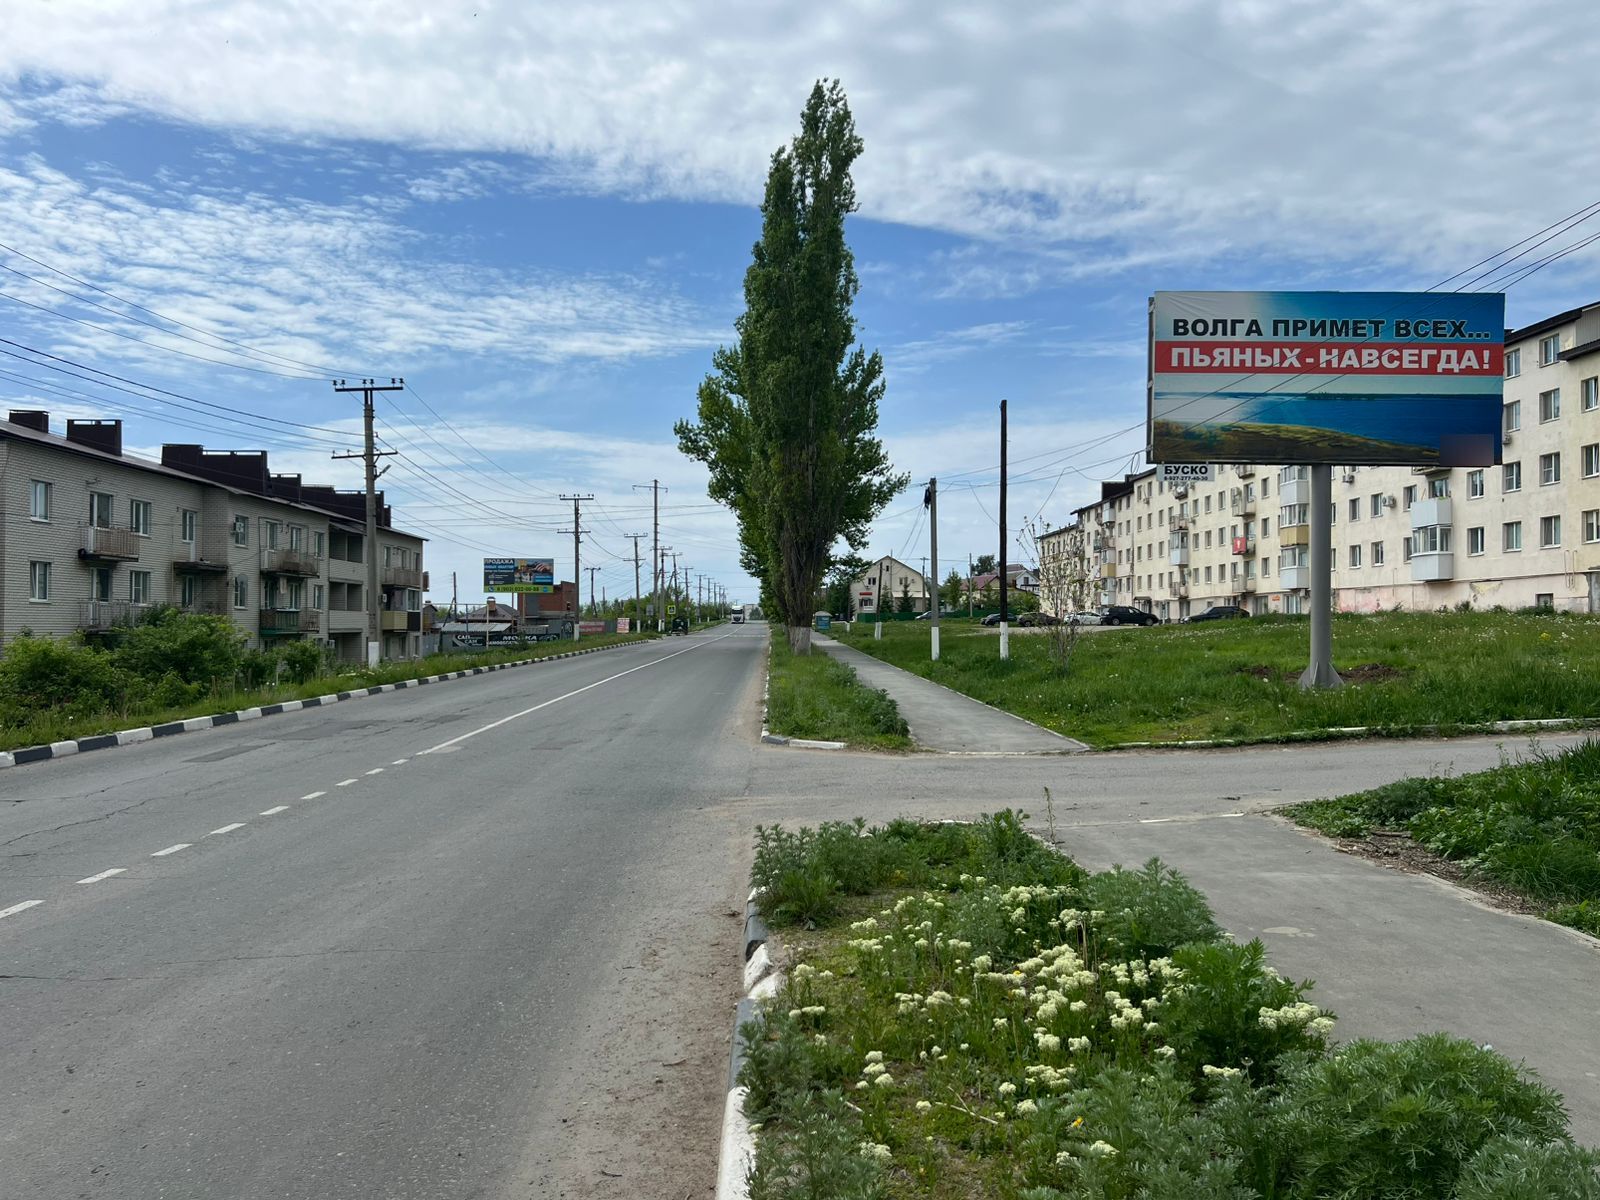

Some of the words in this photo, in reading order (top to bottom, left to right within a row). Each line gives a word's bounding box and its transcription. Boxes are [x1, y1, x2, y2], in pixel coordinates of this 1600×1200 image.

[1173, 319, 1263, 337] ВОЛГА
[1272, 319, 1385, 338] ПРИМЕТ
[1394, 319, 1490, 338] ВСЕХ...
[1164, 466, 1208, 475] БУСКО
